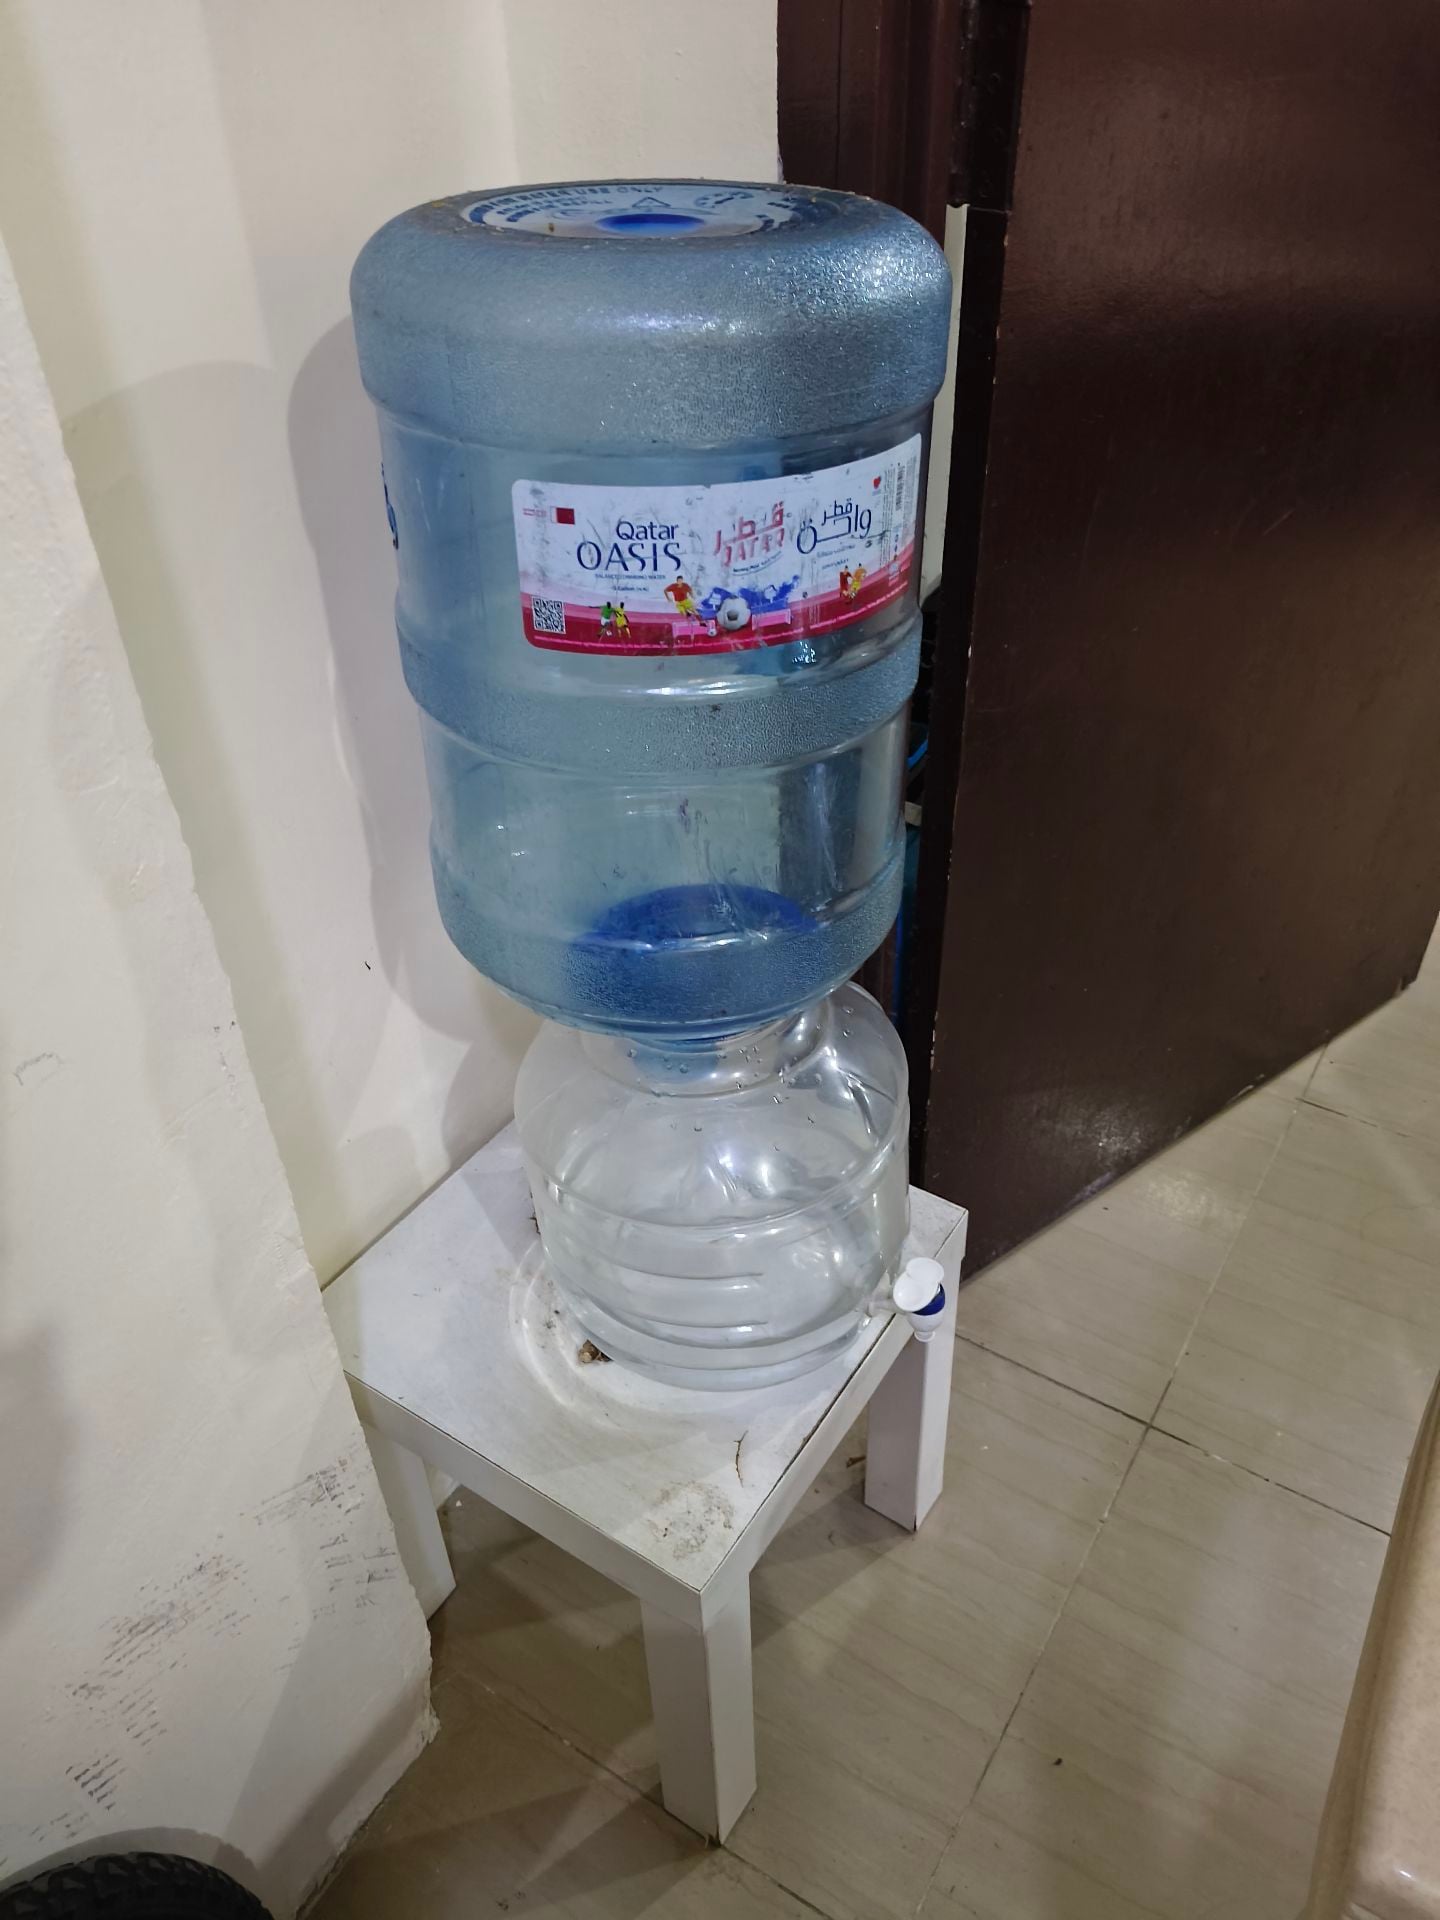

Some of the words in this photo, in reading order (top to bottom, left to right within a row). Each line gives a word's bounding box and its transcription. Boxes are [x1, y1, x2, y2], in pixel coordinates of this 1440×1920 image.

[821, 498, 852, 527] قطر
[616, 521, 679, 541] Qatar
[576, 541, 681, 572] OASIS
